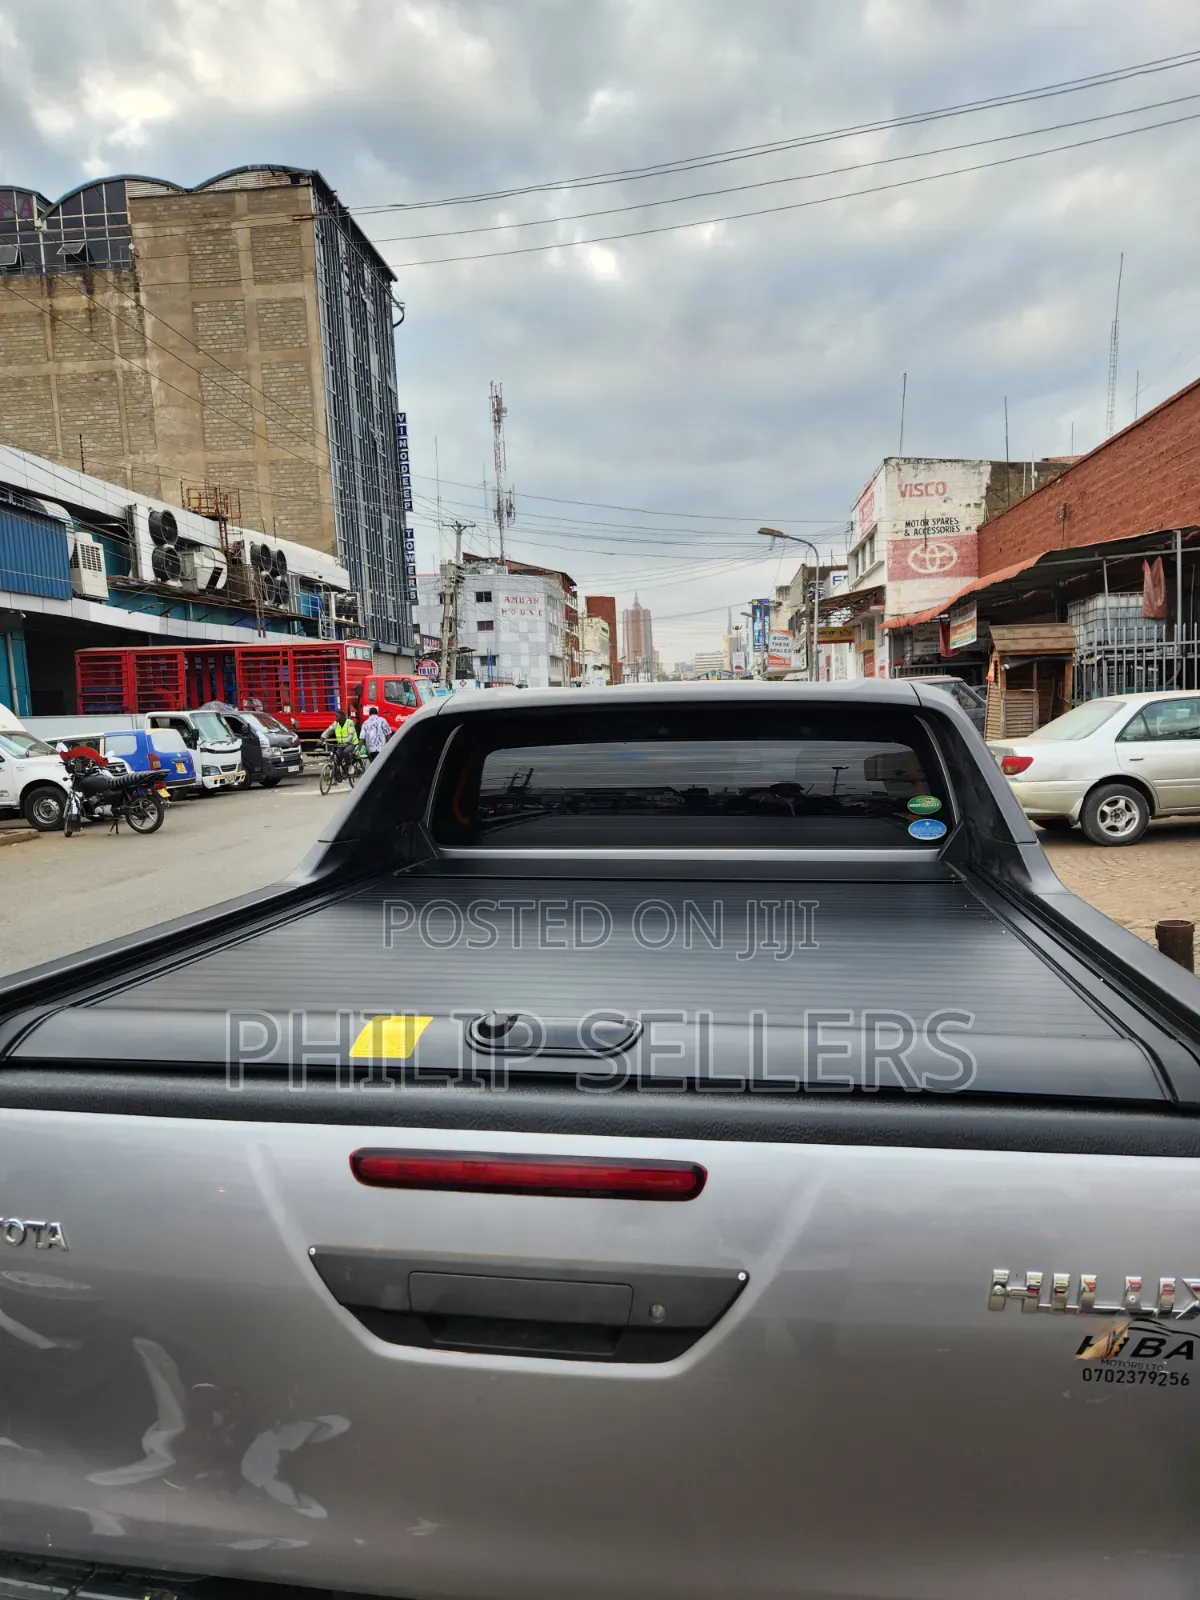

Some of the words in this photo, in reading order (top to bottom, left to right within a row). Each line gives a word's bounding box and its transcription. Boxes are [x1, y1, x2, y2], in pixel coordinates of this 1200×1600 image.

[898, 481, 947, 498] VISCO
[398, 414, 412, 511] VINODEEP
[405, 529, 418, 601] TOWERS
[904, 519, 929, 528] MOTOR
[932, 517, 959, 526] SPARES
[913, 525, 960, 535] ACCESSORIES
[504, 596, 539, 604] AMBAR
[501, 608, 543, 616] HOUSE
[0, 1217, 69, 1251] OTA
[1101, 1358, 1144, 1370] MOTORS
[1146, 1363, 1164, 1371] LTD
[1082, 1367, 1190, 1387] 0702379256
